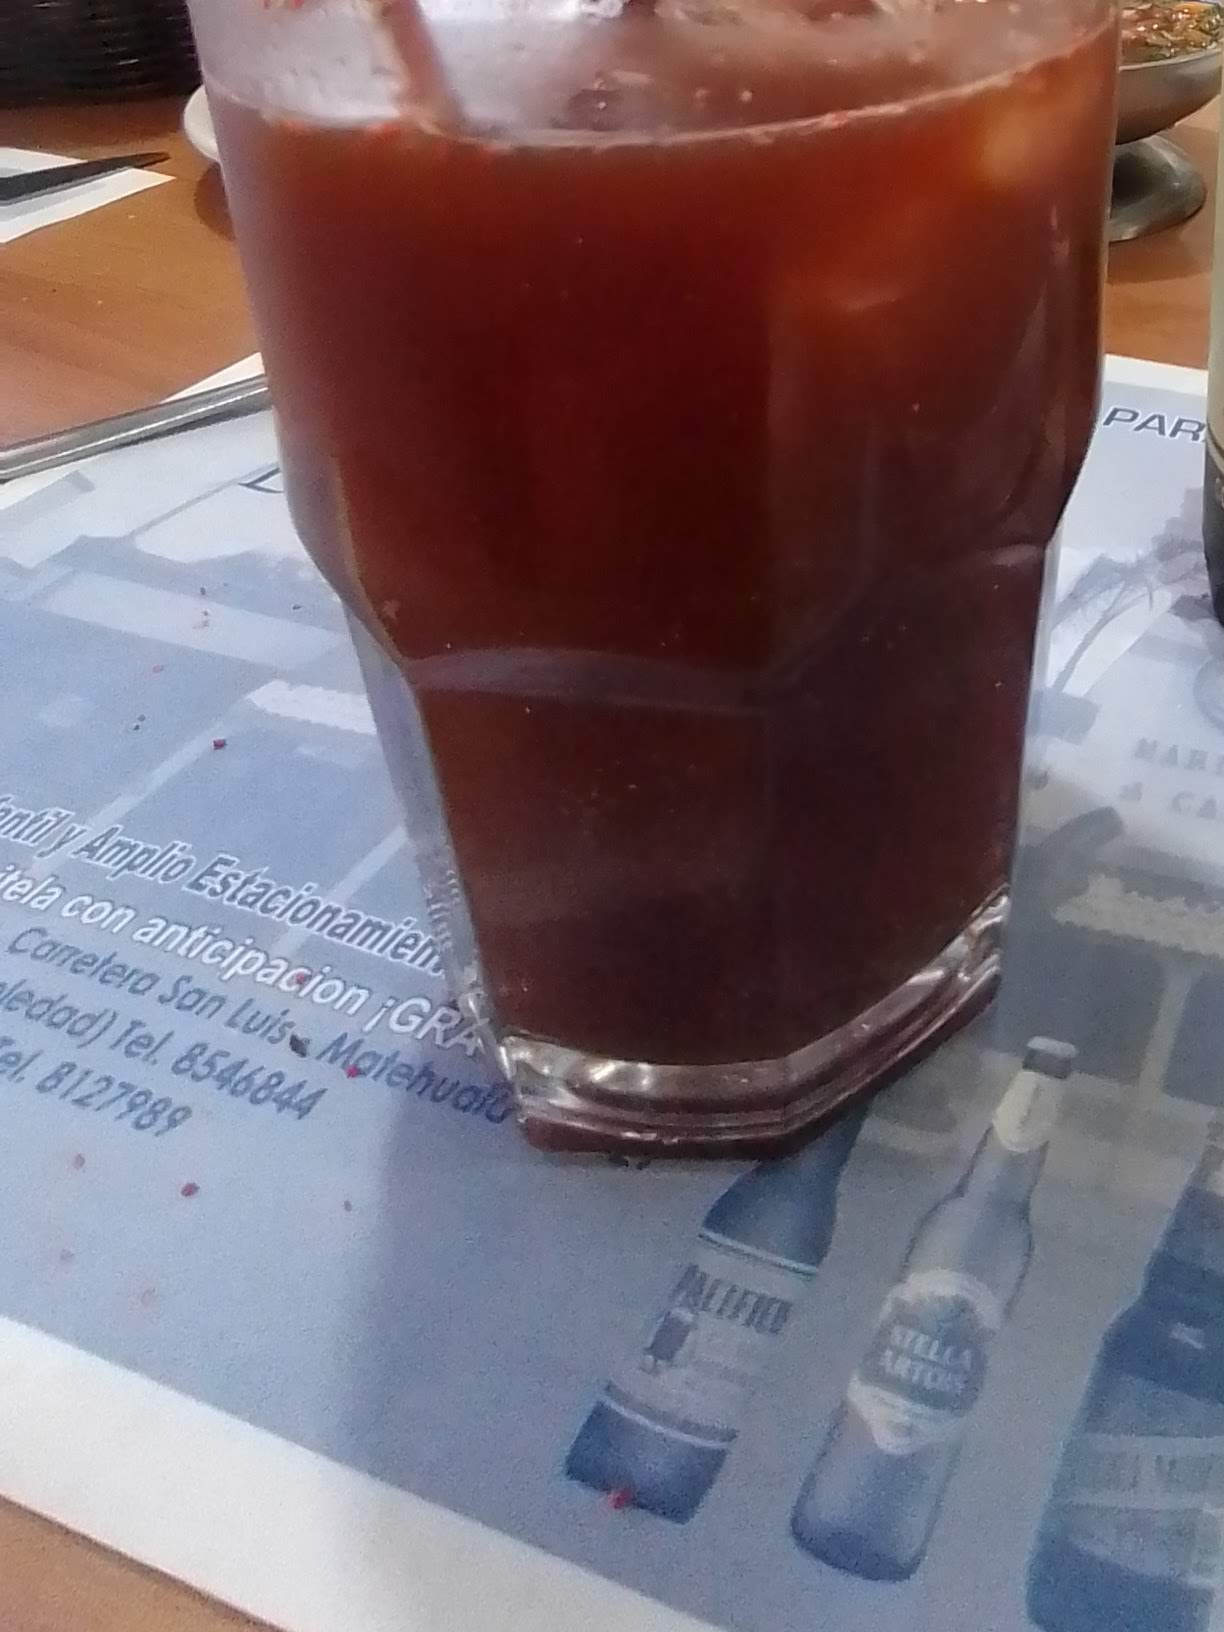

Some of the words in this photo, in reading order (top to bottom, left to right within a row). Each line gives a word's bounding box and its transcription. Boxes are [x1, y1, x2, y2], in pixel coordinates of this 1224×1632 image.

[1103, 407, 1206, 442] PAR
[37, 825, 88, 858] y
[72, 824, 195, 882] Amplio
[187, 855, 446, 975] Estacionamien
[61, 895, 136, 934] con
[132, 917, 370, 1016] anticipacion
[8, 928, 160, 996] Carretera
[158, 975, 226, 1019] San
[225, 998, 295, 1045] Luis
[0, 979, 116, 1049] ledad)
[110, 1020, 174, 1066] Tel.
[171, 1042, 328, 1120] 8546844
[36, 1061, 193, 1136] 8127989
